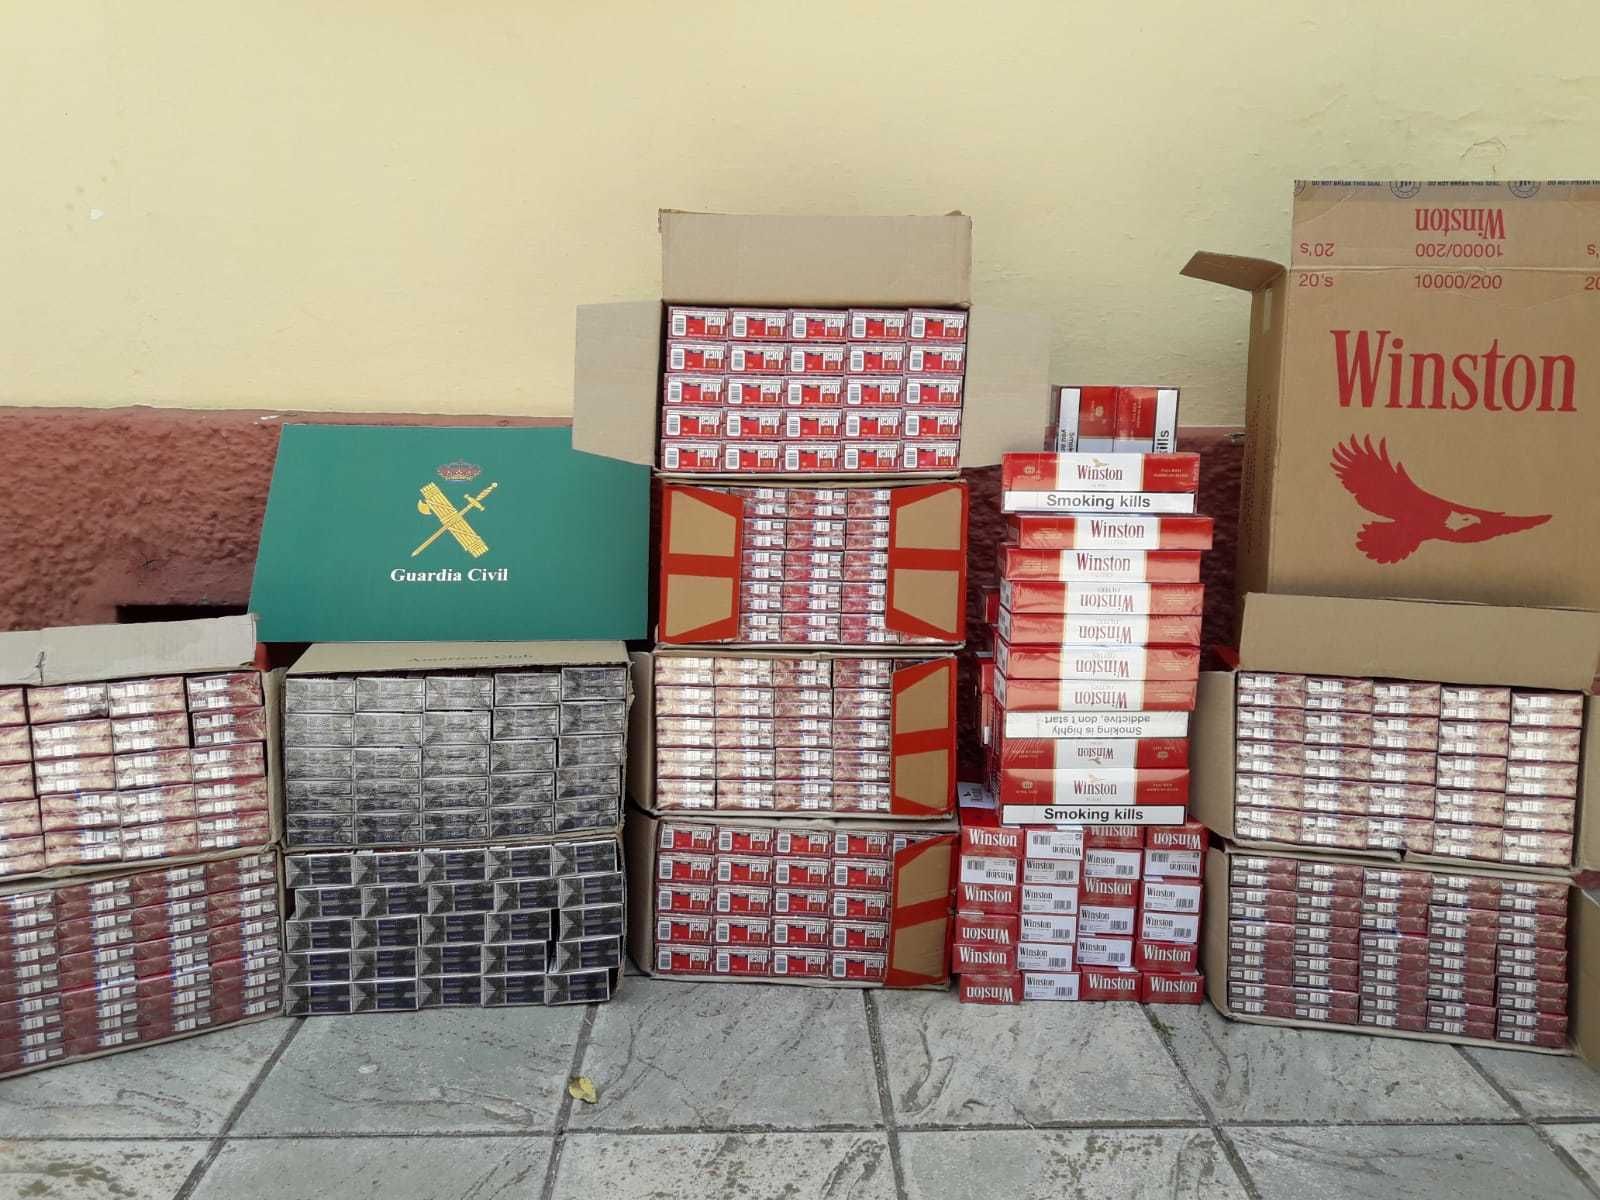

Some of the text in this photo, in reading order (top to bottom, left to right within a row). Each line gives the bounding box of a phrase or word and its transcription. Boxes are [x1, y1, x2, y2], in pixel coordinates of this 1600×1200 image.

[1416, 209, 1505, 239] Winston
[1300, 243, 1334, 256] 20's
[1416, 243, 1504, 258] 10000/200
[1299, 274, 1333, 288] 20's
[1415, 275, 1503, 289] 10000/200
[1330, 330, 1577, 412] Winston
[1077, 465, 1123, 481] Winston
[1047, 494, 1150, 509] Smoking kills
[1091, 520, 1144, 538] Winston
[1077, 553, 1130, 571] Winston
[391, 568, 508, 581] Guardia Civil
[1080, 594, 1133, 612] Winston
[1079, 626, 1132, 643] Winston
[1076, 659, 1129, 677] Winston
[1074, 692, 1127, 709] Winston
[1045, 716, 1069, 724] start
[1052, 727, 1082, 736] highly
[1096, 727, 1142, 735] Smoking
[1078, 747, 1113, 759] Winston
[1074, 781, 1117, 795] Winston
[1044, 808, 1143, 822] Smoking kills
[969, 829, 1017, 847] Winston
[1154, 833, 1201, 849] Winston
[1086, 853, 1115, 865] Winston
[965, 884, 1012, 903] Winston
[1085, 878, 1132, 895] Winston
[1147, 887, 1175, 898] Winston
[1024, 889, 1052, 900] Winston
[1081, 910, 1110, 920] Winston
[1145, 917, 1173, 927] Winston
[1023, 918, 1052, 929] Winston
[962, 927, 1009, 944] Winston
[1019, 946, 1048, 957] Winston
[1079, 941, 1107, 952] Winston
[1143, 944, 1190, 962] Winston
[960, 945, 1007, 964] Winston
[1026, 976, 1055, 986] Winston
[1089, 974, 1135, 990] Winston
[1151, 977, 1197, 993] Winston
[967, 986, 1013, 1002] Winston
